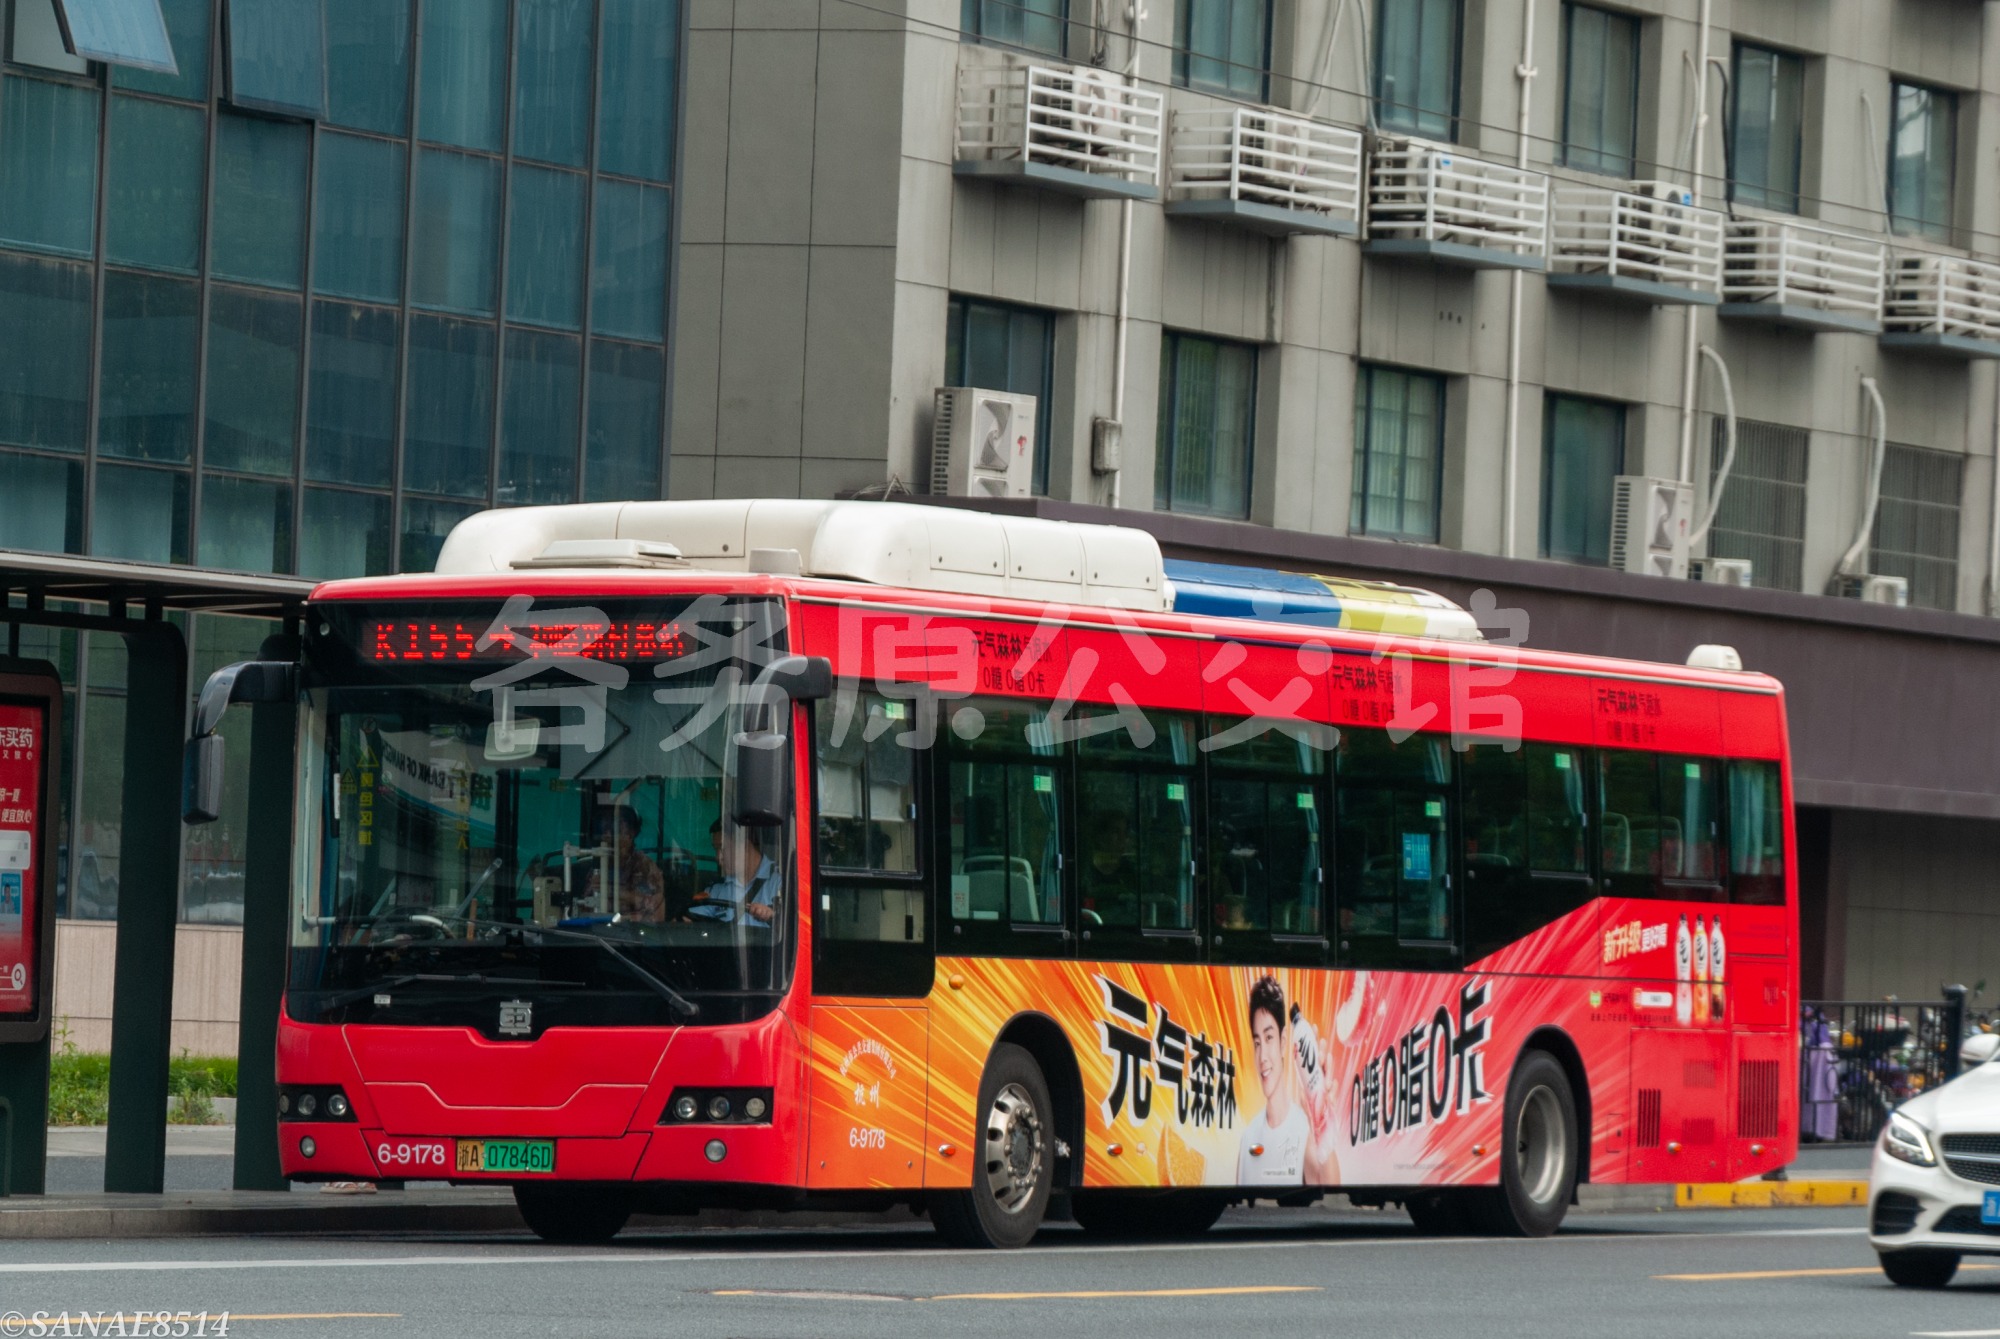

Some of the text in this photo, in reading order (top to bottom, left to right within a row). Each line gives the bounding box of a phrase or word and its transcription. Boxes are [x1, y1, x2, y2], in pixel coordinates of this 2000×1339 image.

[1094, 974, 1236, 1129] 元气森林
[849, 1127, 886, 1149] 6-9178
[378, 1144, 445, 1165] 6-9178
